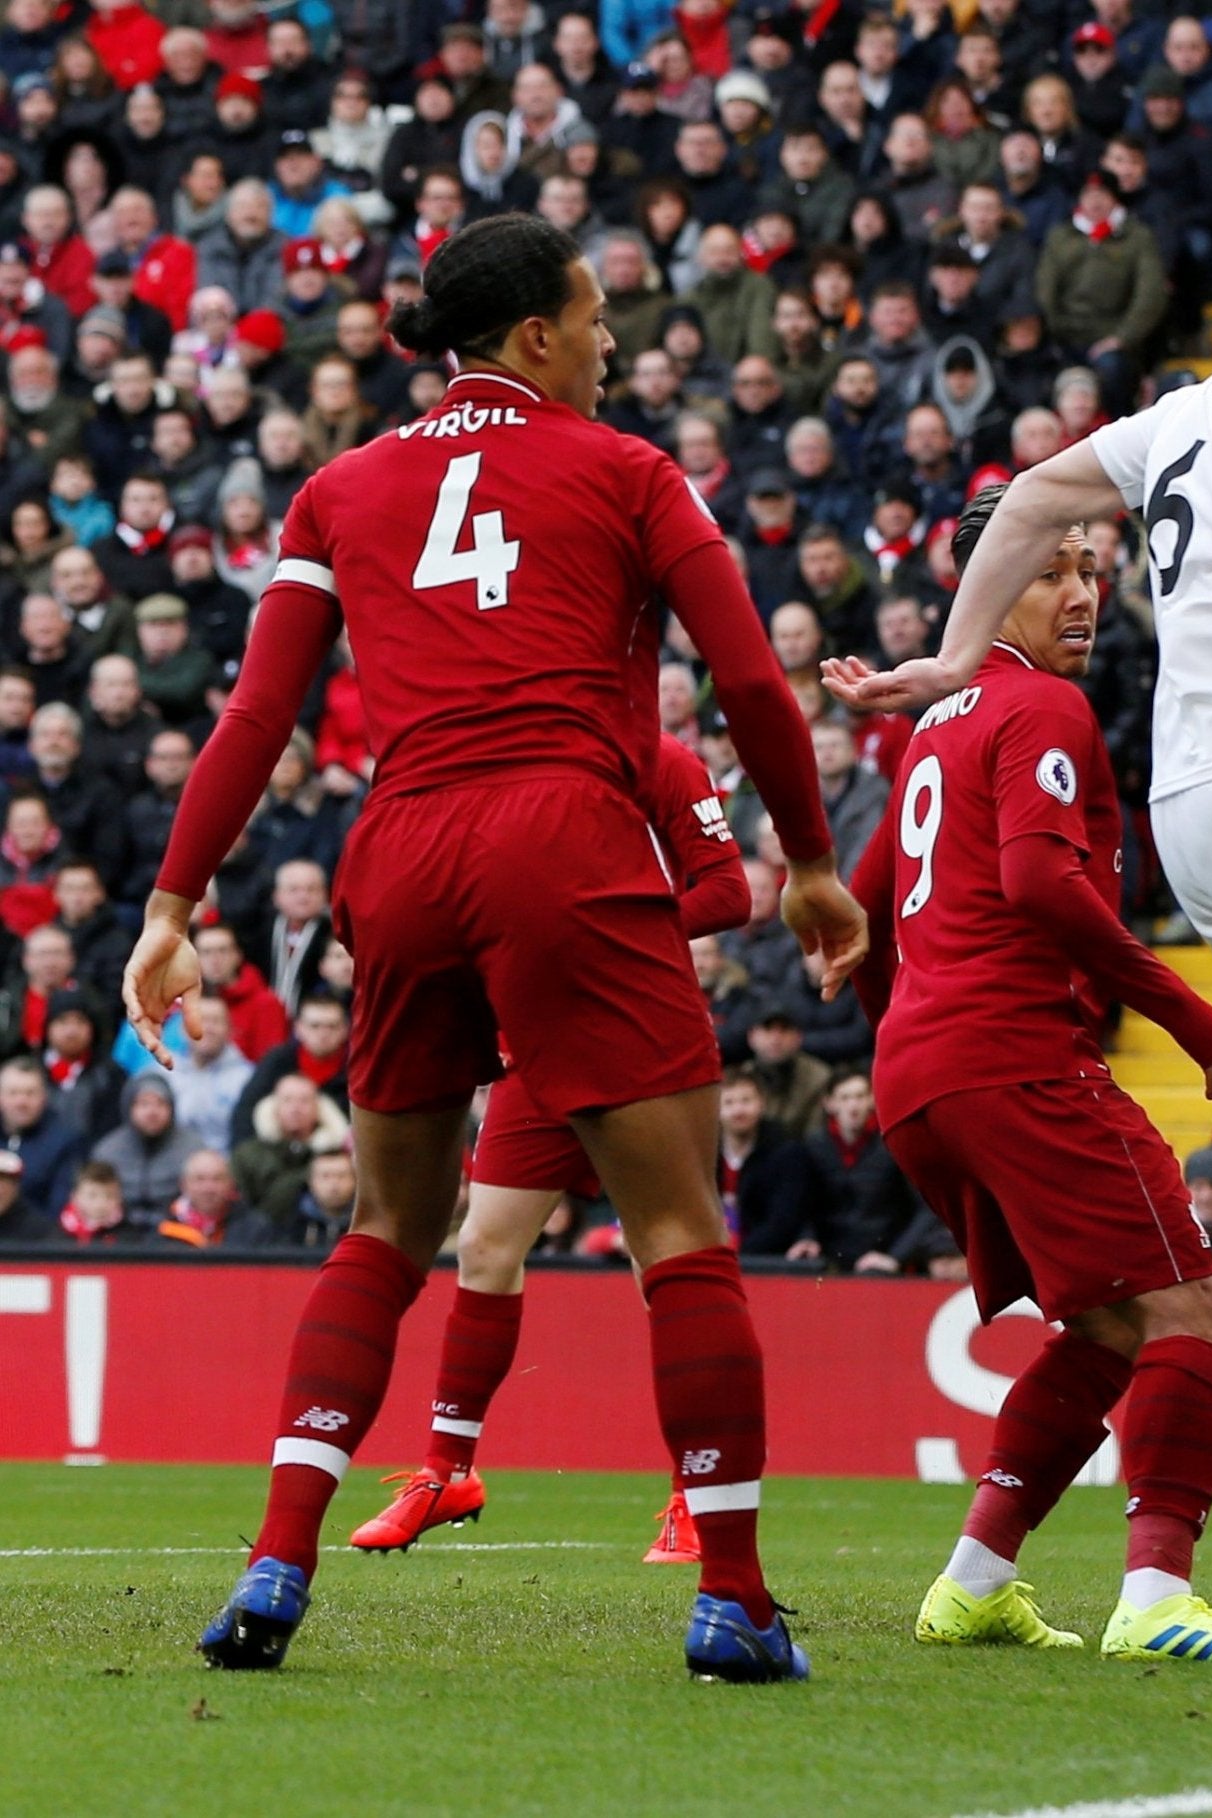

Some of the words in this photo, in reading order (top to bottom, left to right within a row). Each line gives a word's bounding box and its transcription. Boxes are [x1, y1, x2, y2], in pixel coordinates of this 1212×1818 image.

[398, 406, 528, 440] VIRGIL
[412, 450, 522, 611] 4
[1146, 439, 1206, 597] 6
[901, 754, 943, 918] 9
